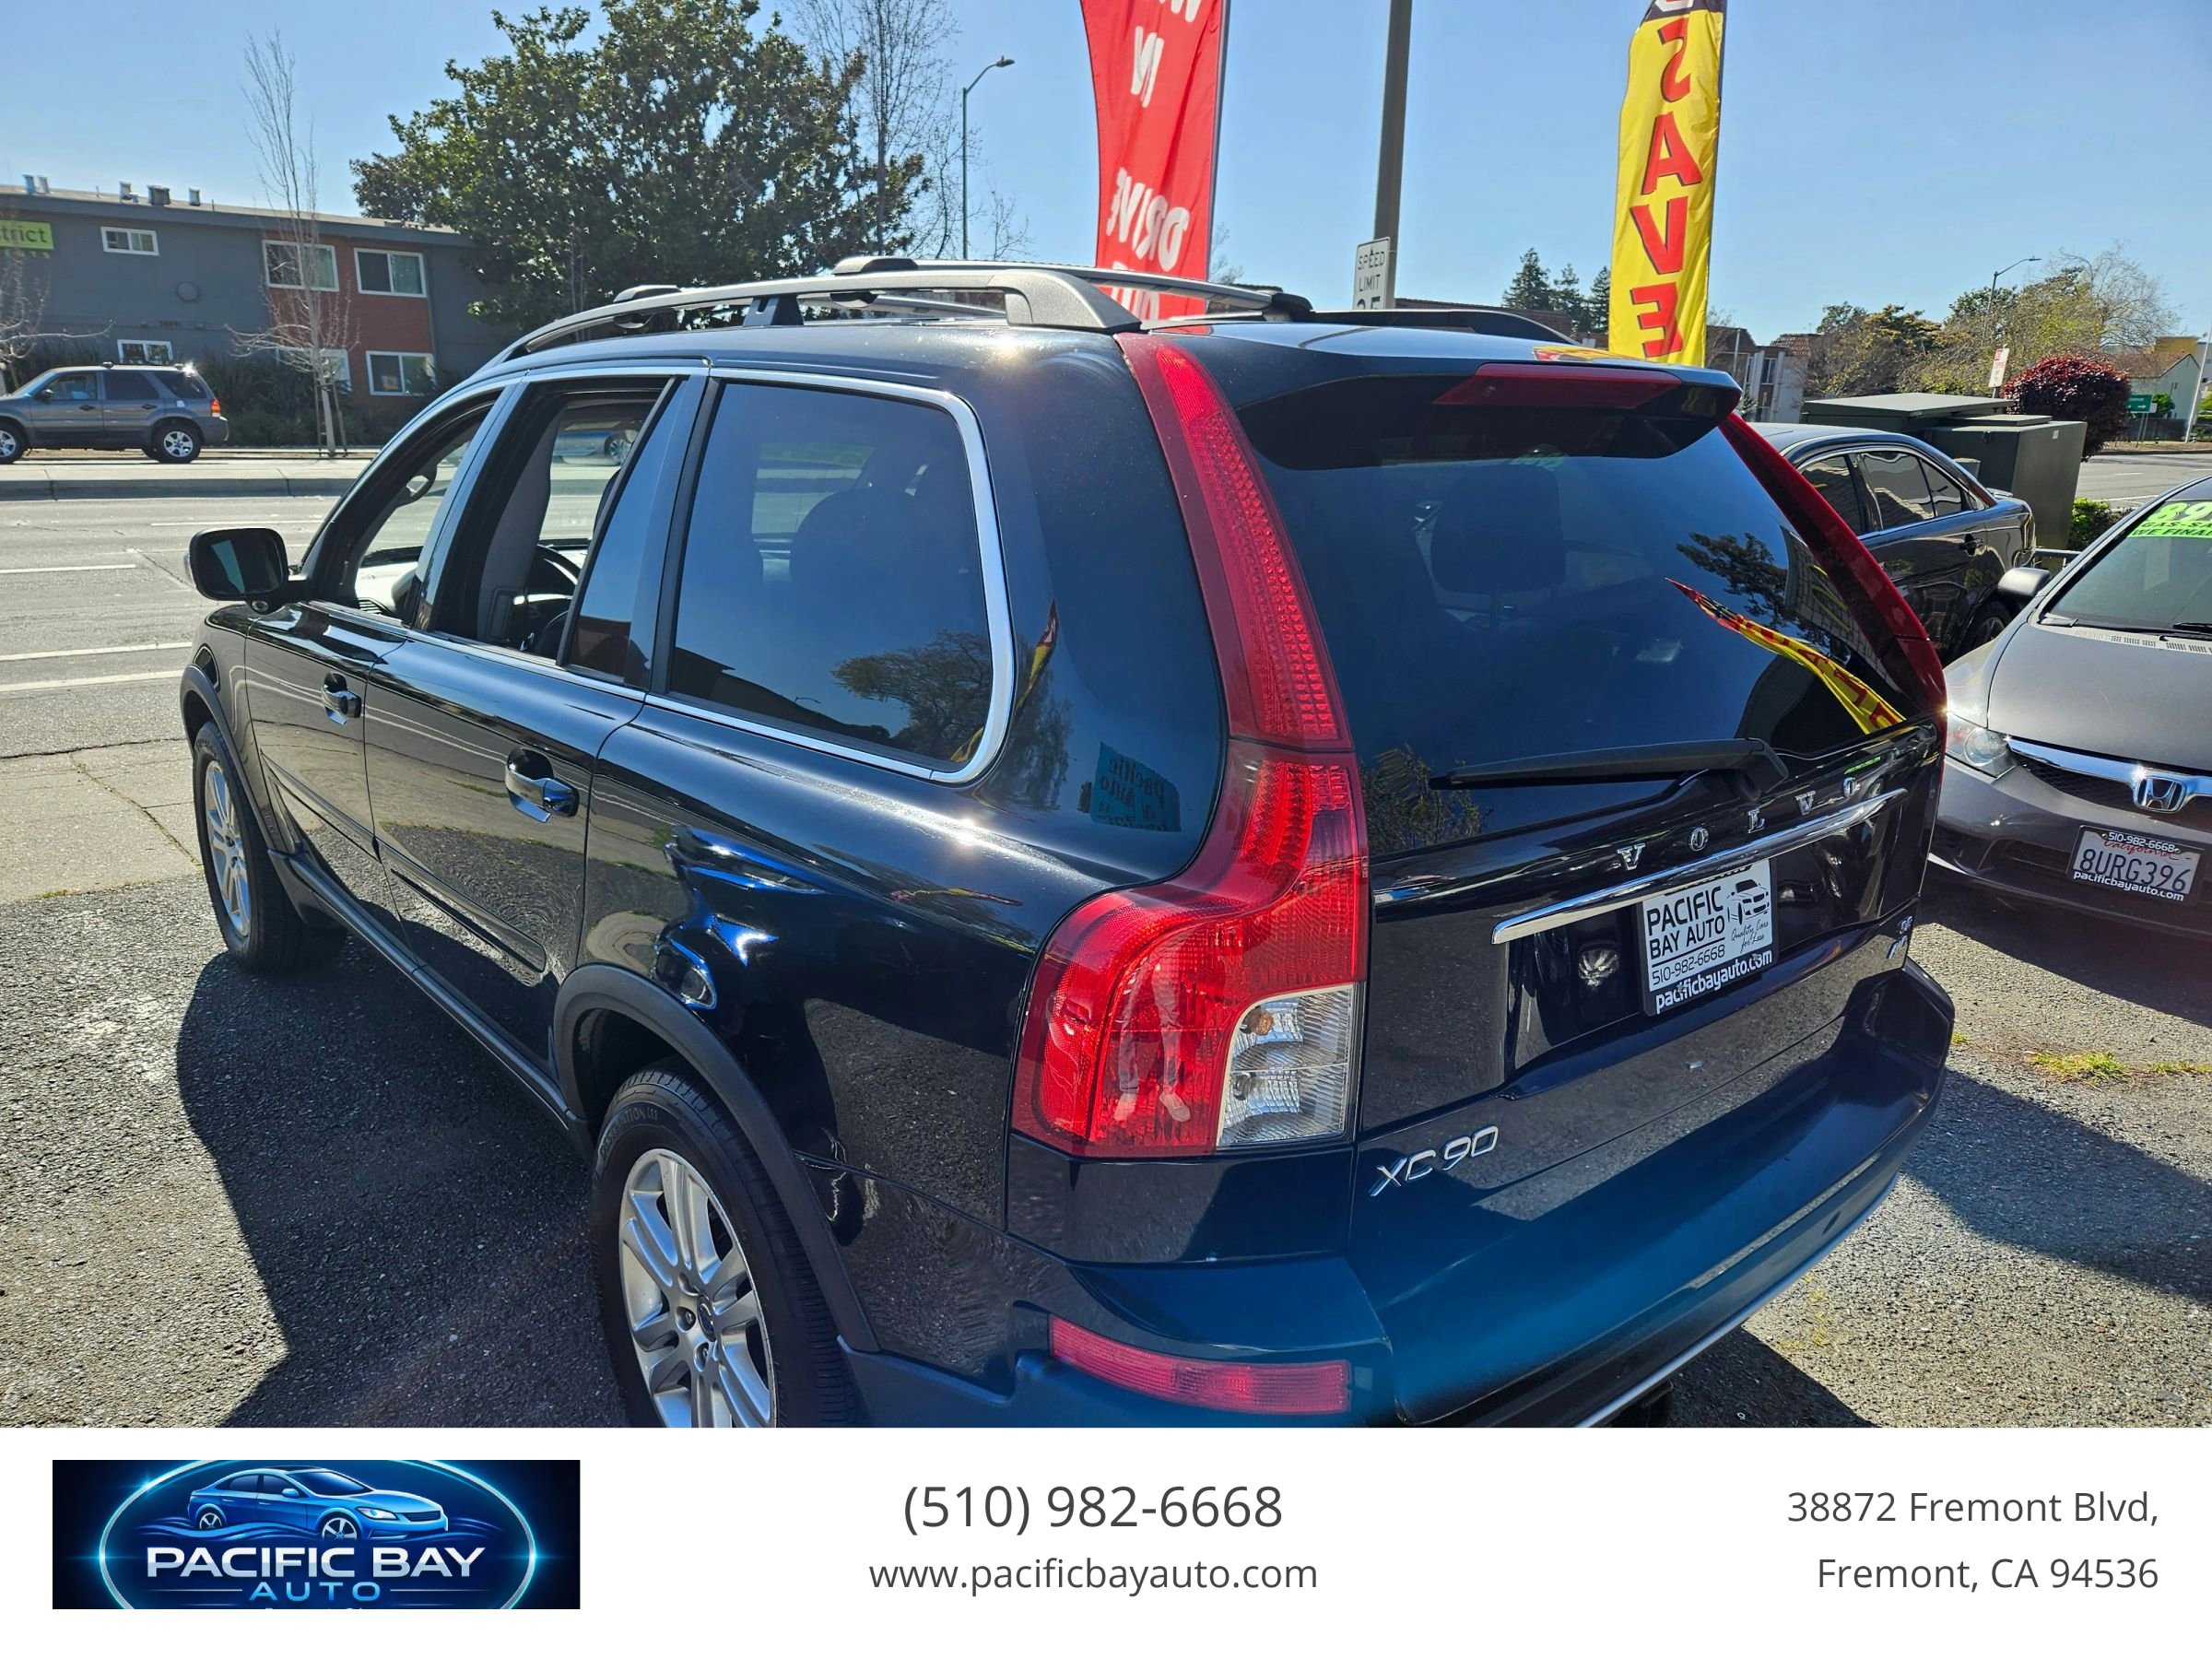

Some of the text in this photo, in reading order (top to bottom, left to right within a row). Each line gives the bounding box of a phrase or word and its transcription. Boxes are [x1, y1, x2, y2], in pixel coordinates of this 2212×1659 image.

[1357, 251, 1385, 270] SPEED
[1359, 274, 1381, 292] LIMIT
[1616, 776, 1862, 871] VOLVO
[2107, 831, 2176, 853] 510-982-6668
[2073, 870, 2184, 901] pacificbayauto.com
[2079, 848, 2192, 892] 8URG396
[1646, 886, 1724, 936] PACIFIC
[1649, 915, 1725, 960] BAY AUTO
[1652, 944, 1726, 986] 510-982-6668
[1655, 949, 1773, 1015] pacificbayauto.com
